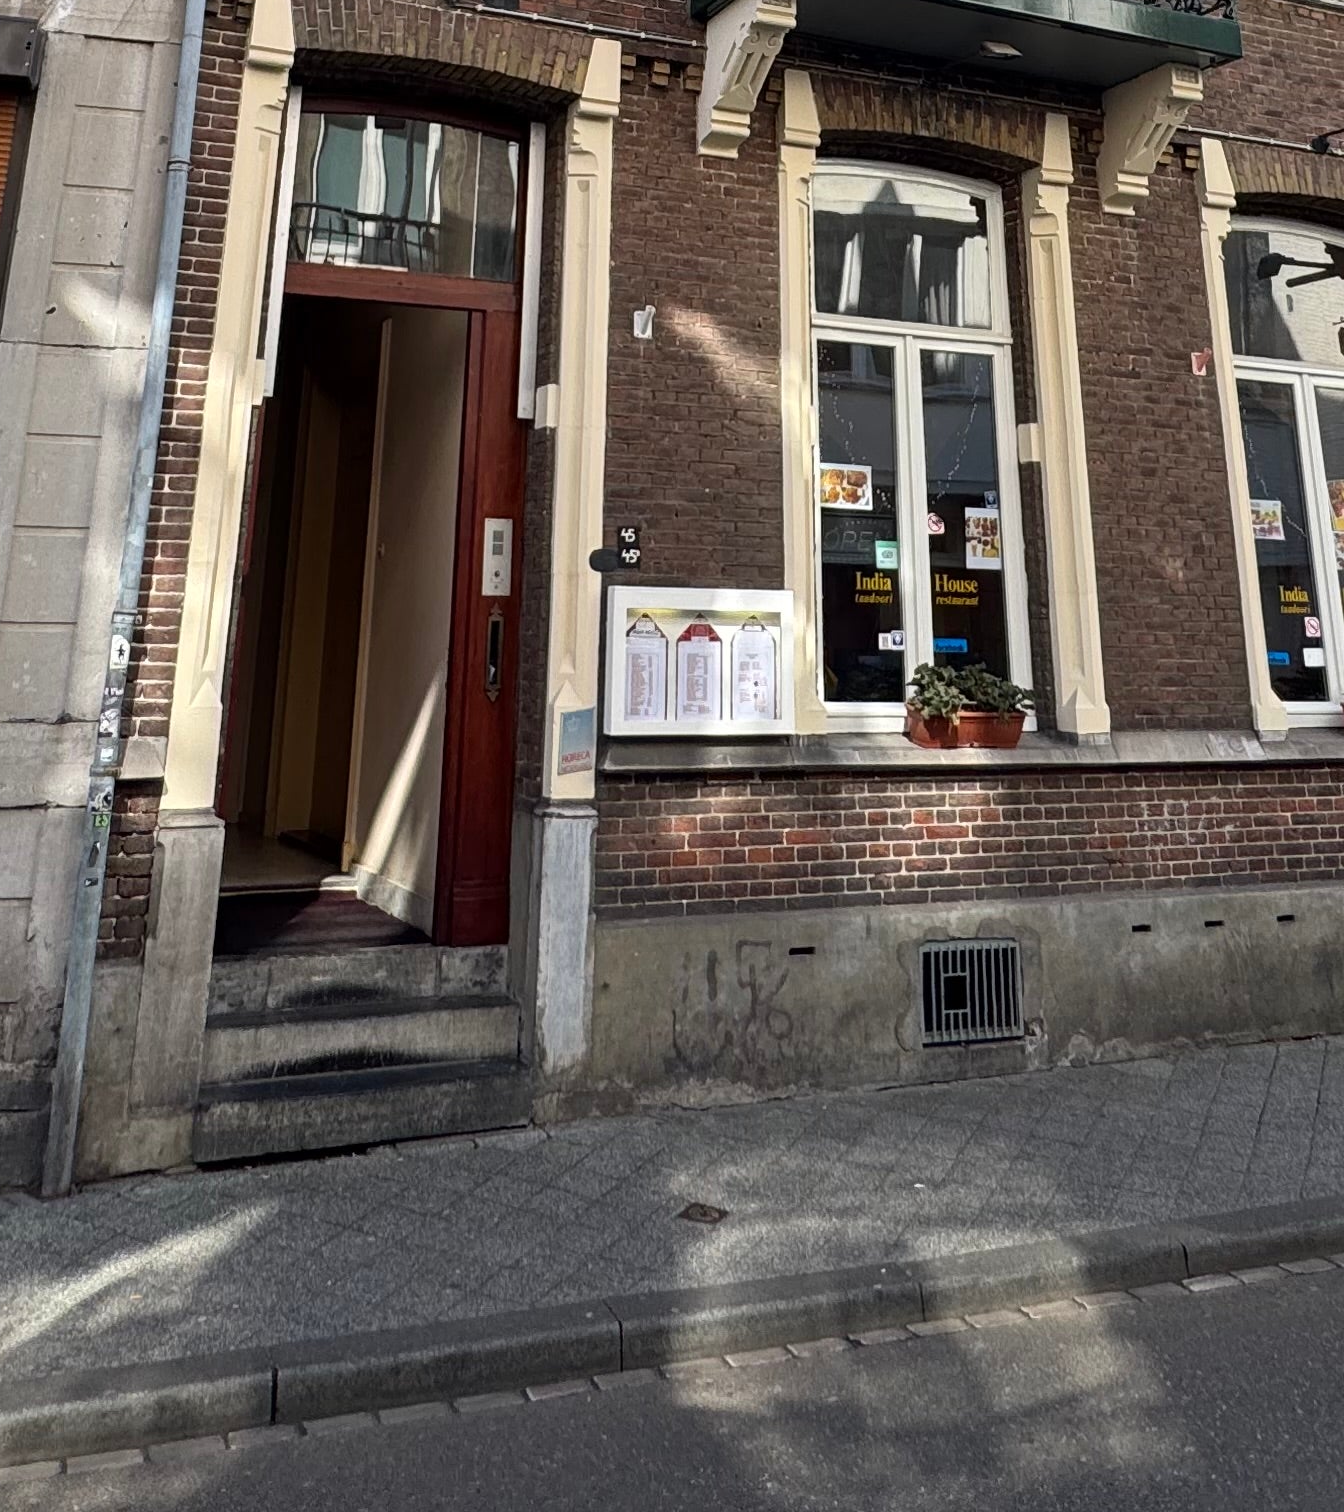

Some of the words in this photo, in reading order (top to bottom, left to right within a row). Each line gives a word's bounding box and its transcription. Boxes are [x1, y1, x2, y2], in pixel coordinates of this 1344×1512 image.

[621, 528, 636, 542] 45
[855, 571, 893, 591] India
[935, 573, 979, 593] House
[1279, 585, 1309, 602] India
